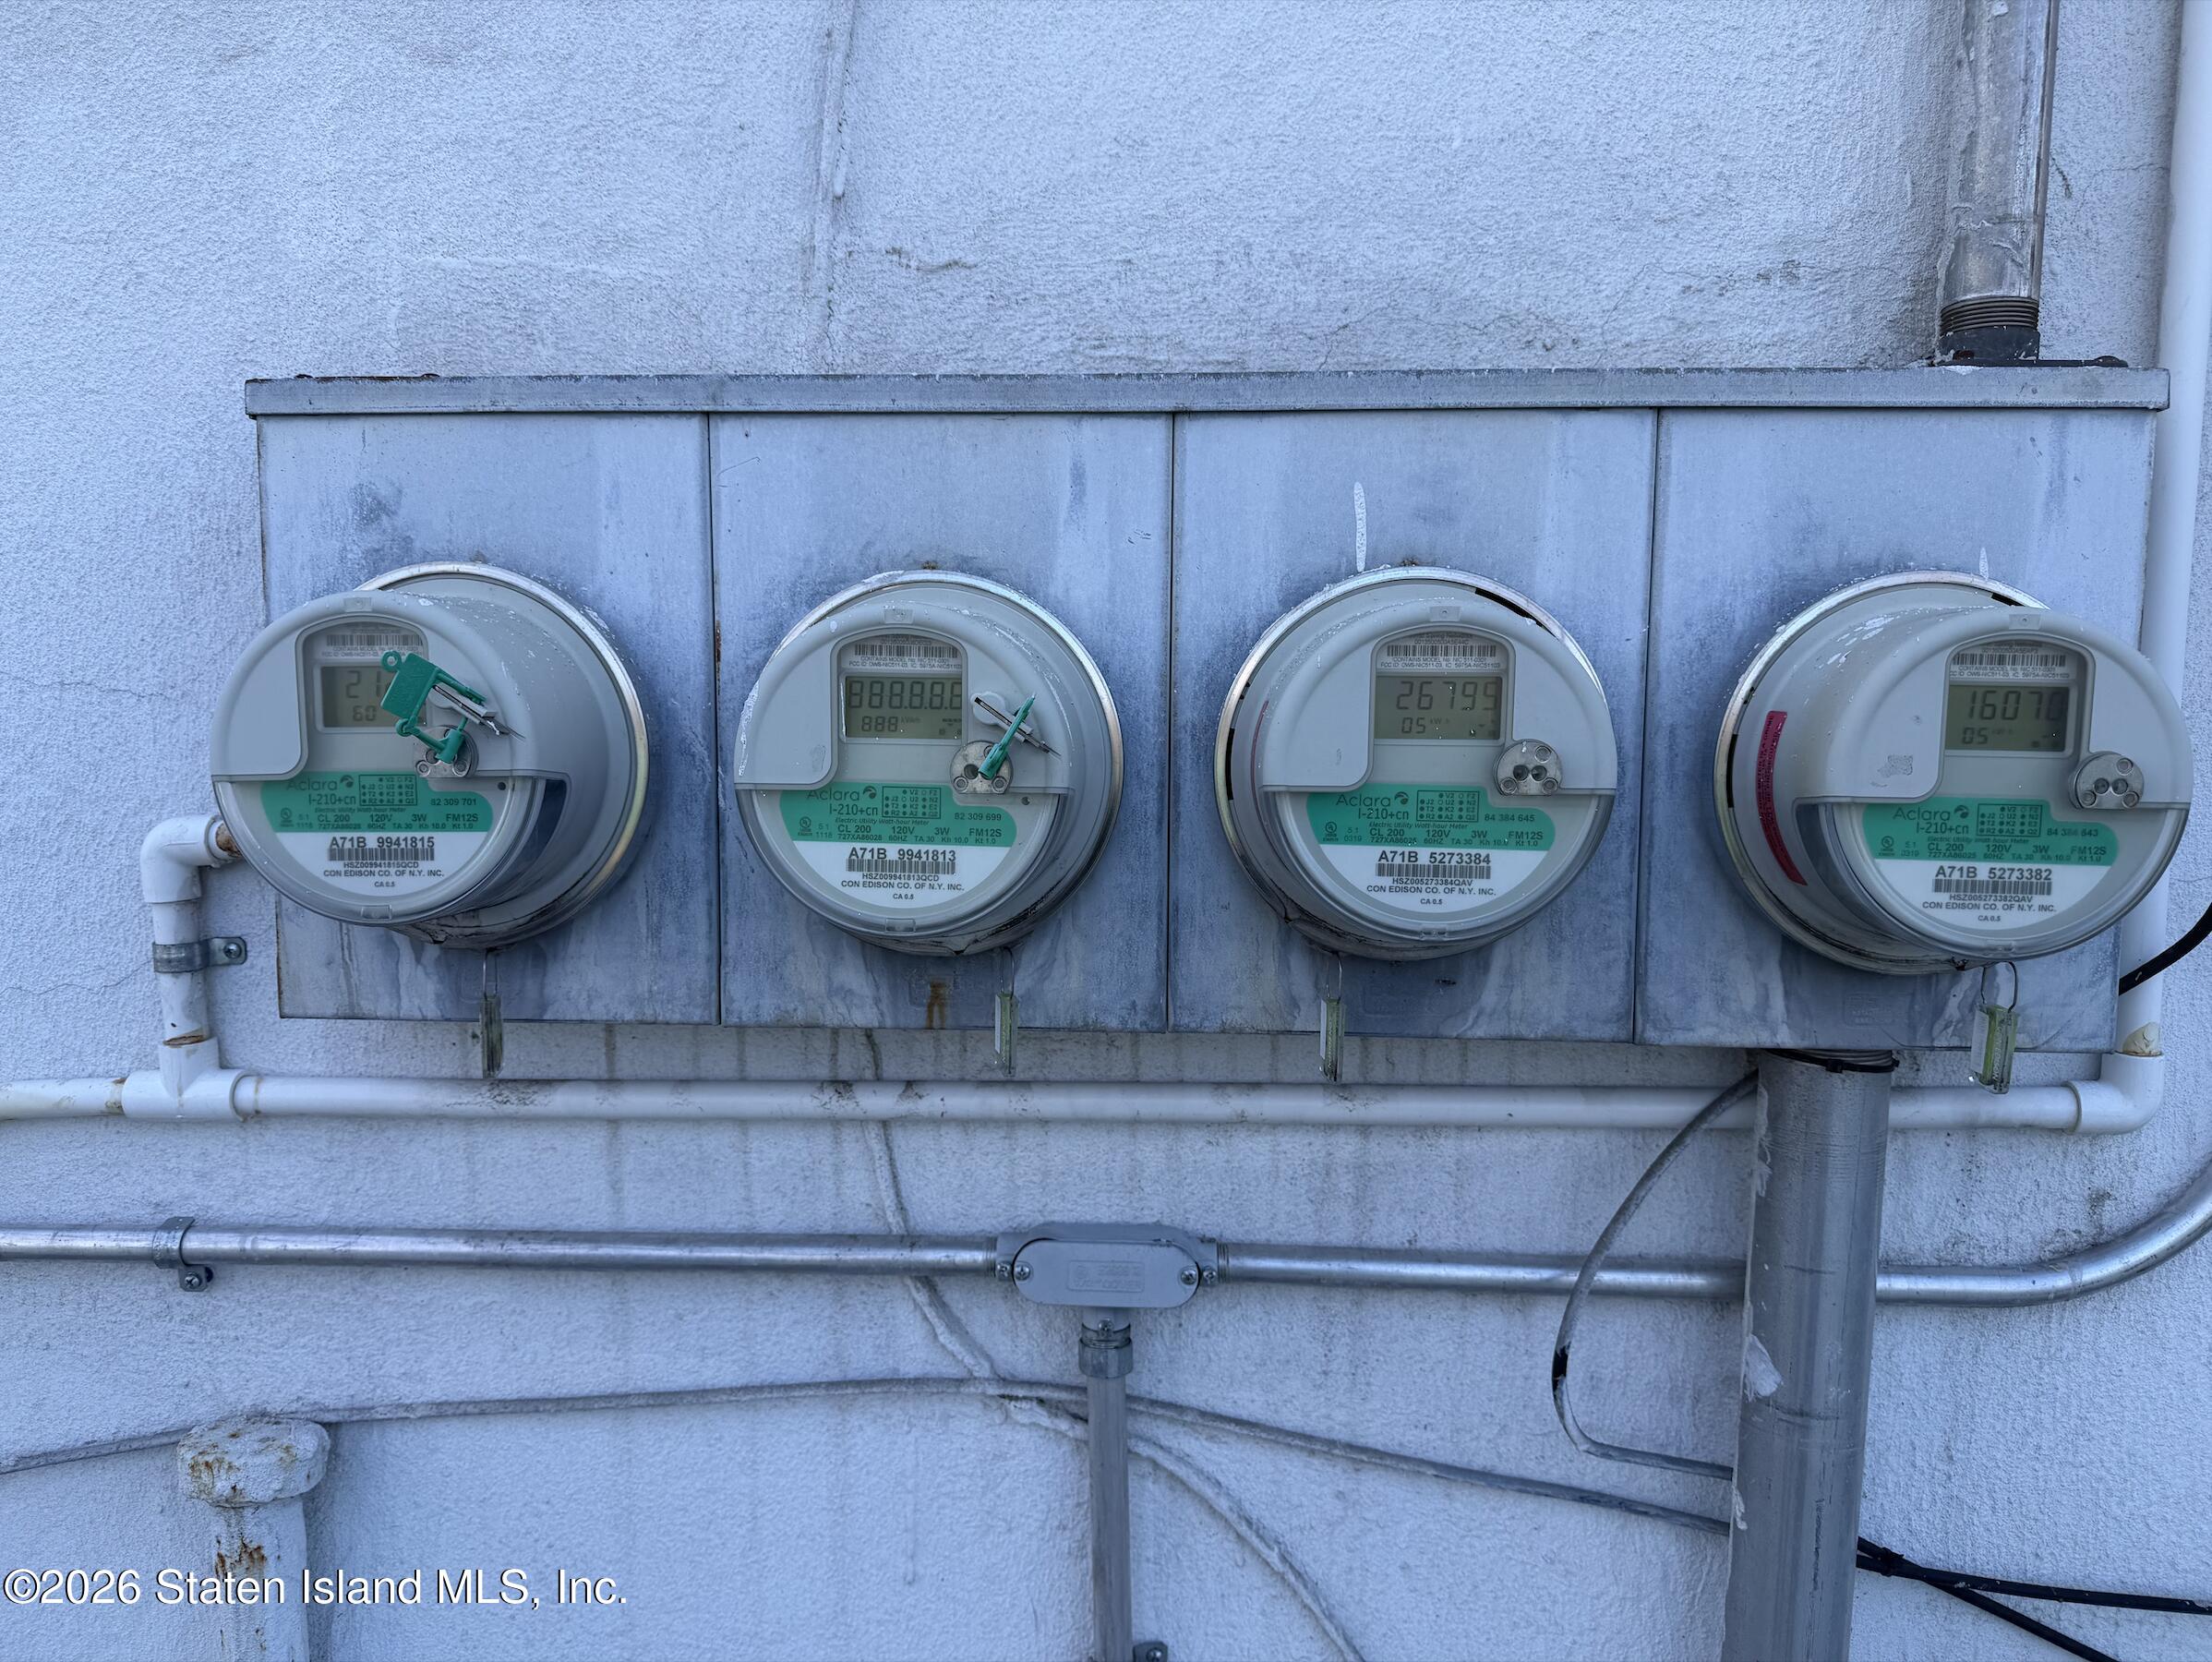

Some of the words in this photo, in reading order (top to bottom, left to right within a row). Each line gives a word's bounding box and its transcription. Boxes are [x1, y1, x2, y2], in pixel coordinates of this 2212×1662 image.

[807, 788, 860, 801] Aclara
[1336, 794, 1390, 807] Aclara
[830, 803, 877, 815] I-210+cn
[1359, 809, 1409, 821] I-210+cn
[1893, 807, 1950, 821] Aclara
[318, 814, 331, 823] CL
[334, 814, 350, 823] 200
[370, 814, 392, 823] 120V
[412, 814, 427, 823] 3W
[446, 813, 478, 822] FM12S
[838, 825, 852, 833] CL
[856, 825, 872, 834] 200
[969, 828, 1002, 837] FM12S
[1370, 828, 1385, 837] CL
[1388, 829, 1404, 837] 200
[1426, 830, 1450, 838] 120V
[1509, 832, 1543, 840] FM12S
[1917, 822, 1968, 834] I-210+cn
[330, 837, 367, 848] A71B
[378, 837, 434, 848] 9941815
[848, 848, 886, 860] A71B
[898, 849, 956, 861] 9941813
[1928, 843, 1943, 851] CL
[1946, 843, 1964, 851] 200
[1987, 844, 2012, 852] 120V
[2033, 845, 2050, 853] 3W
[2071, 846, 2106, 855] FM12S
[1378, 850, 1418, 863] A71B
[1429, 852, 1491, 864] 5273384
[1936, 865, 1977, 878] A71B
[1988, 867, 2051, 880] 5273382
[1392, 878, 1473, 886] HSZ005273384QAV
[1389, 885, 1422, 894] EDISON
